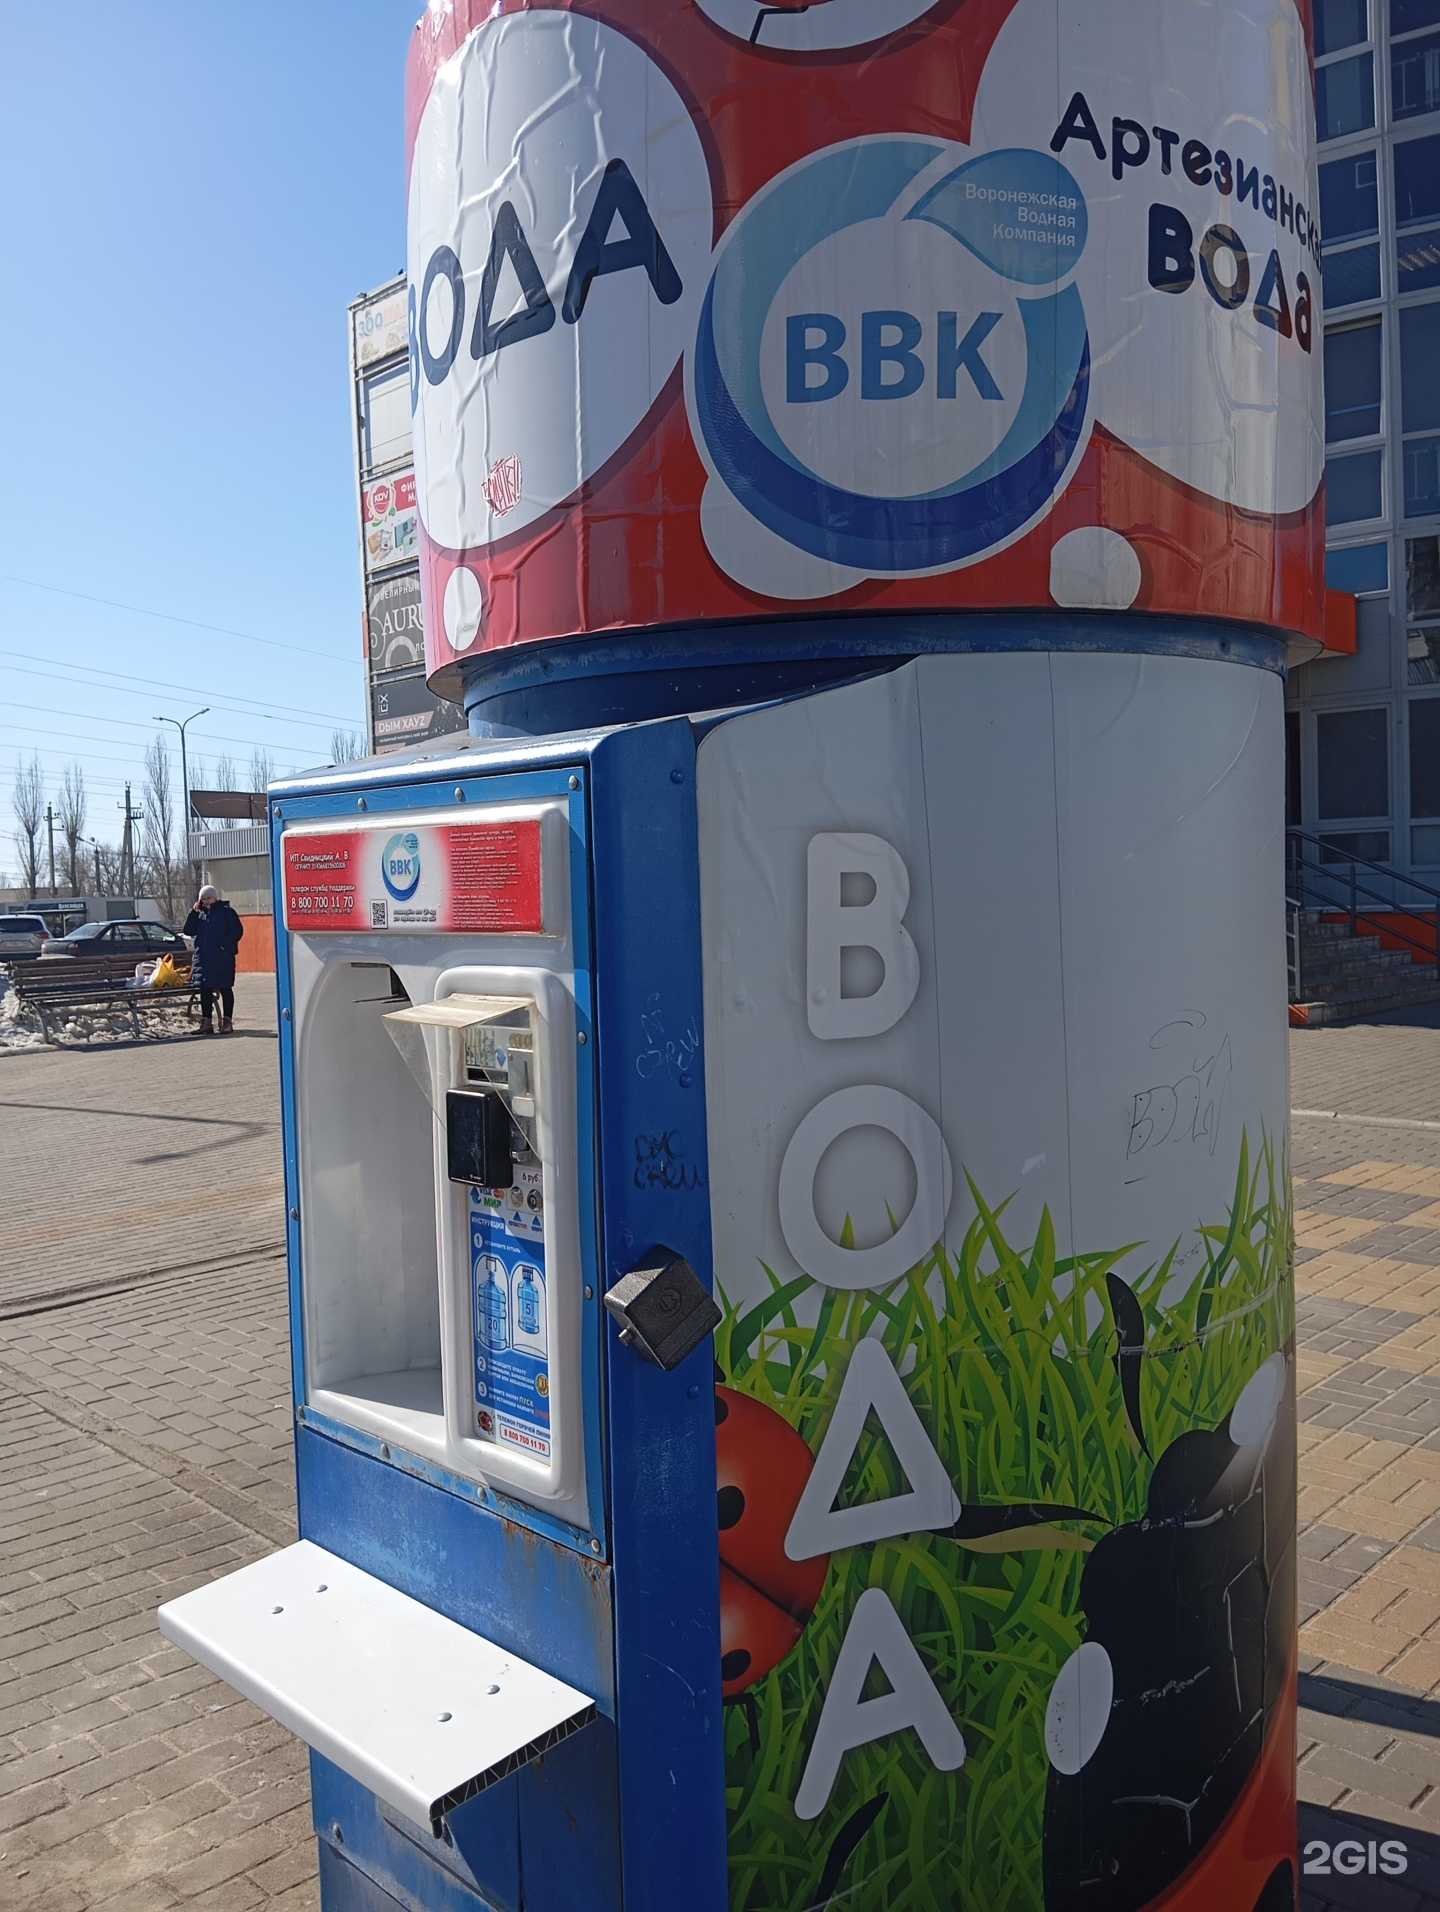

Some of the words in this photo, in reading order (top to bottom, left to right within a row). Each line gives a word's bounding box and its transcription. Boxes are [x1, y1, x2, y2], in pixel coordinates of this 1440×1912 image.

[966, 183, 1076, 209] Воронежская
[1018, 206, 1075, 228] Водная
[993, 223, 1075, 247] Компания
[408, 157, 684, 418] ВОДА
[787, 310, 1004, 403] ВВК
[390, 859, 411, 875] ВВК
[291, 897, 296, 908] 8
[299, 896, 312, 908] 800
[314, 896, 329, 908] 700
[332, 896, 340, 908] 11
[344, 895, 354, 908] 70
